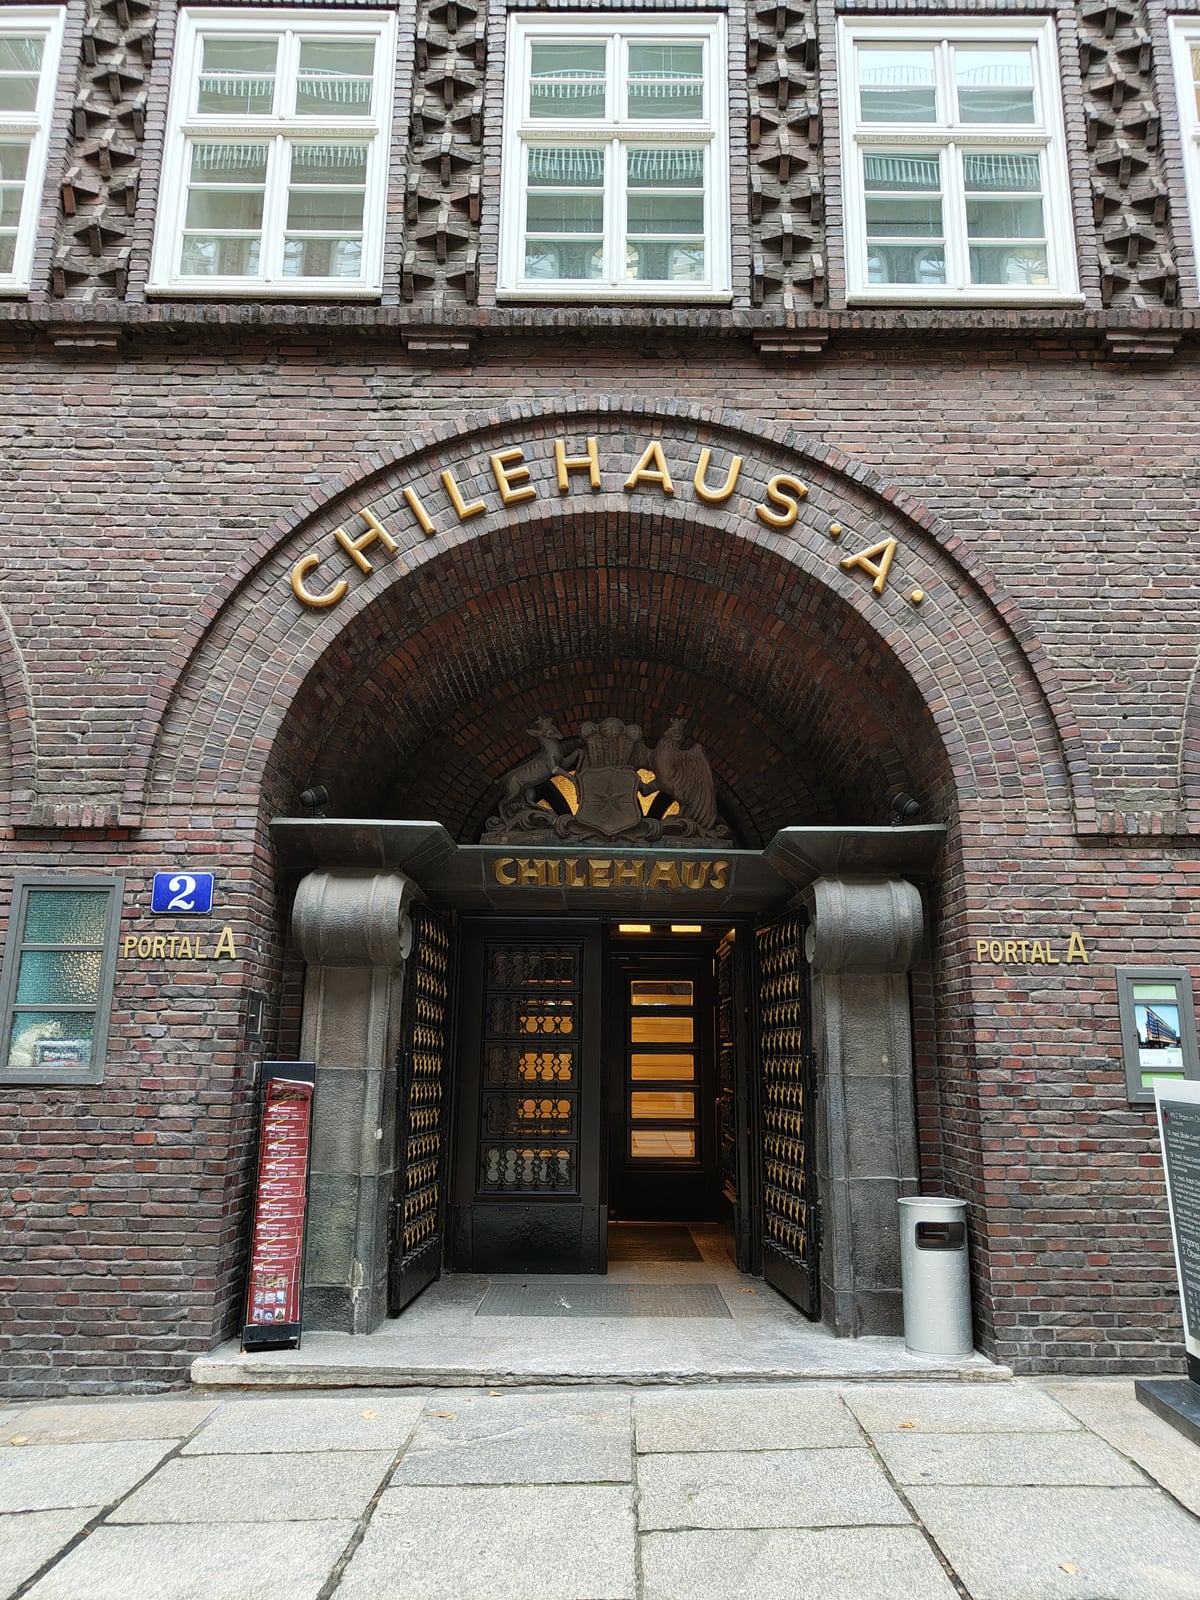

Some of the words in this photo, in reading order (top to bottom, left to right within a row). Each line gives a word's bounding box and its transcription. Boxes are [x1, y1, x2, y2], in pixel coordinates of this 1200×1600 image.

[291, 437, 809, 607] CHILEHAUS
[492, 858, 730, 889] CHILEHAUS
[167, 875, 196, 910] 2
[123, 936, 208, 959] PORTAL
[213, 927, 237, 959] A
[976, 940, 1060, 963] PORTAL
[1066, 931, 1089, 963] A
